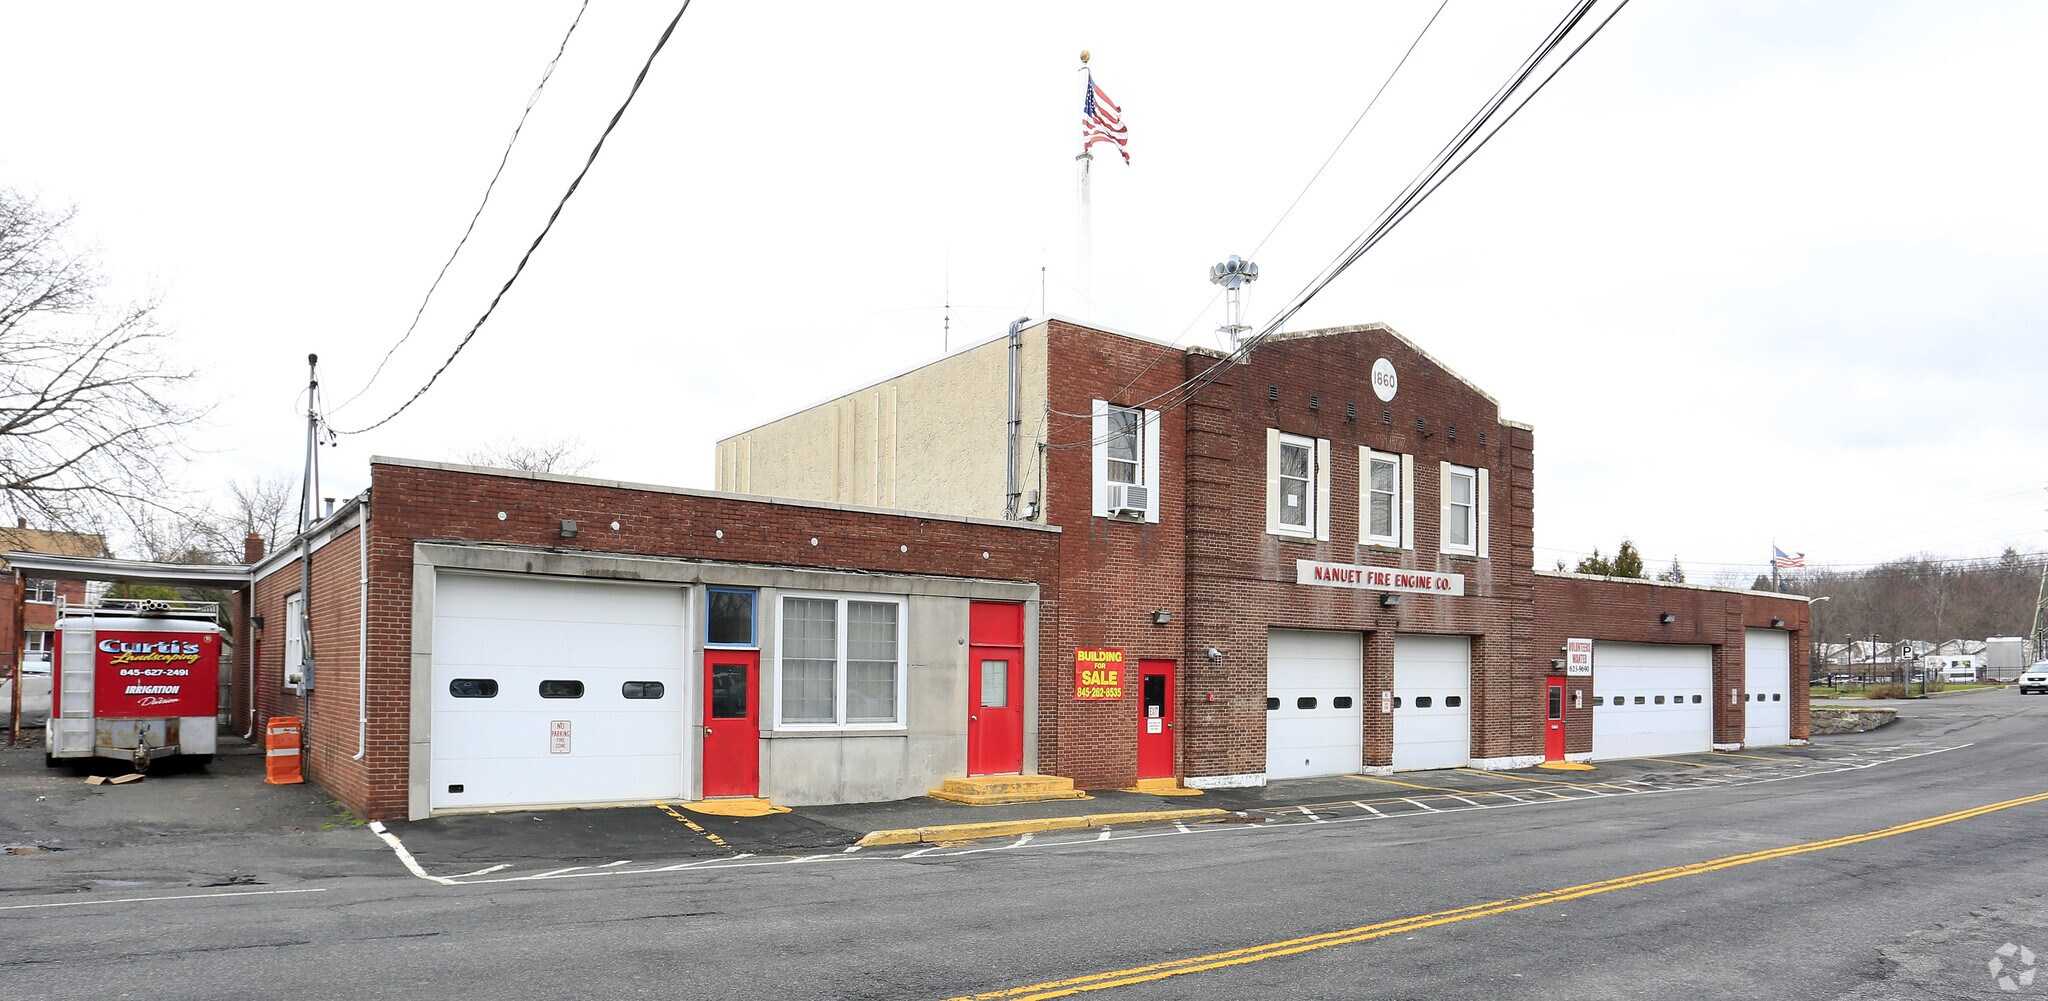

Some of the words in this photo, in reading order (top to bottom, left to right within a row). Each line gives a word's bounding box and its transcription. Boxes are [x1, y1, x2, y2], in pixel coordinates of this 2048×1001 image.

[1374, 371, 1395, 388] 1860
[1315, 566, 1362, 583] NANUET
[1367, 571, 1391, 586] FIRE
[1395, 573, 1432, 589] ENGINE
[1436, 577, 1451, 590] CO.
[98, 639, 199, 653] Curti's
[1569, 642, 1590, 652] VOLUNTEERS
[1903, 646, 1912, 657] P
[110, 652, 201, 665] Landscaping
[1077, 651, 1122, 662] BUILDING
[1572, 654, 1587, 664] WANTED
[120, 668, 189, 676] 845-627-2491
[1081, 670, 1118, 686] SALE
[125, 685, 181, 695] IRRIGATION
[1077, 687, 1122, 697] 845-262-8535
[137, 696, 181, 707] Division
[556, 722, 565, 730] NO
